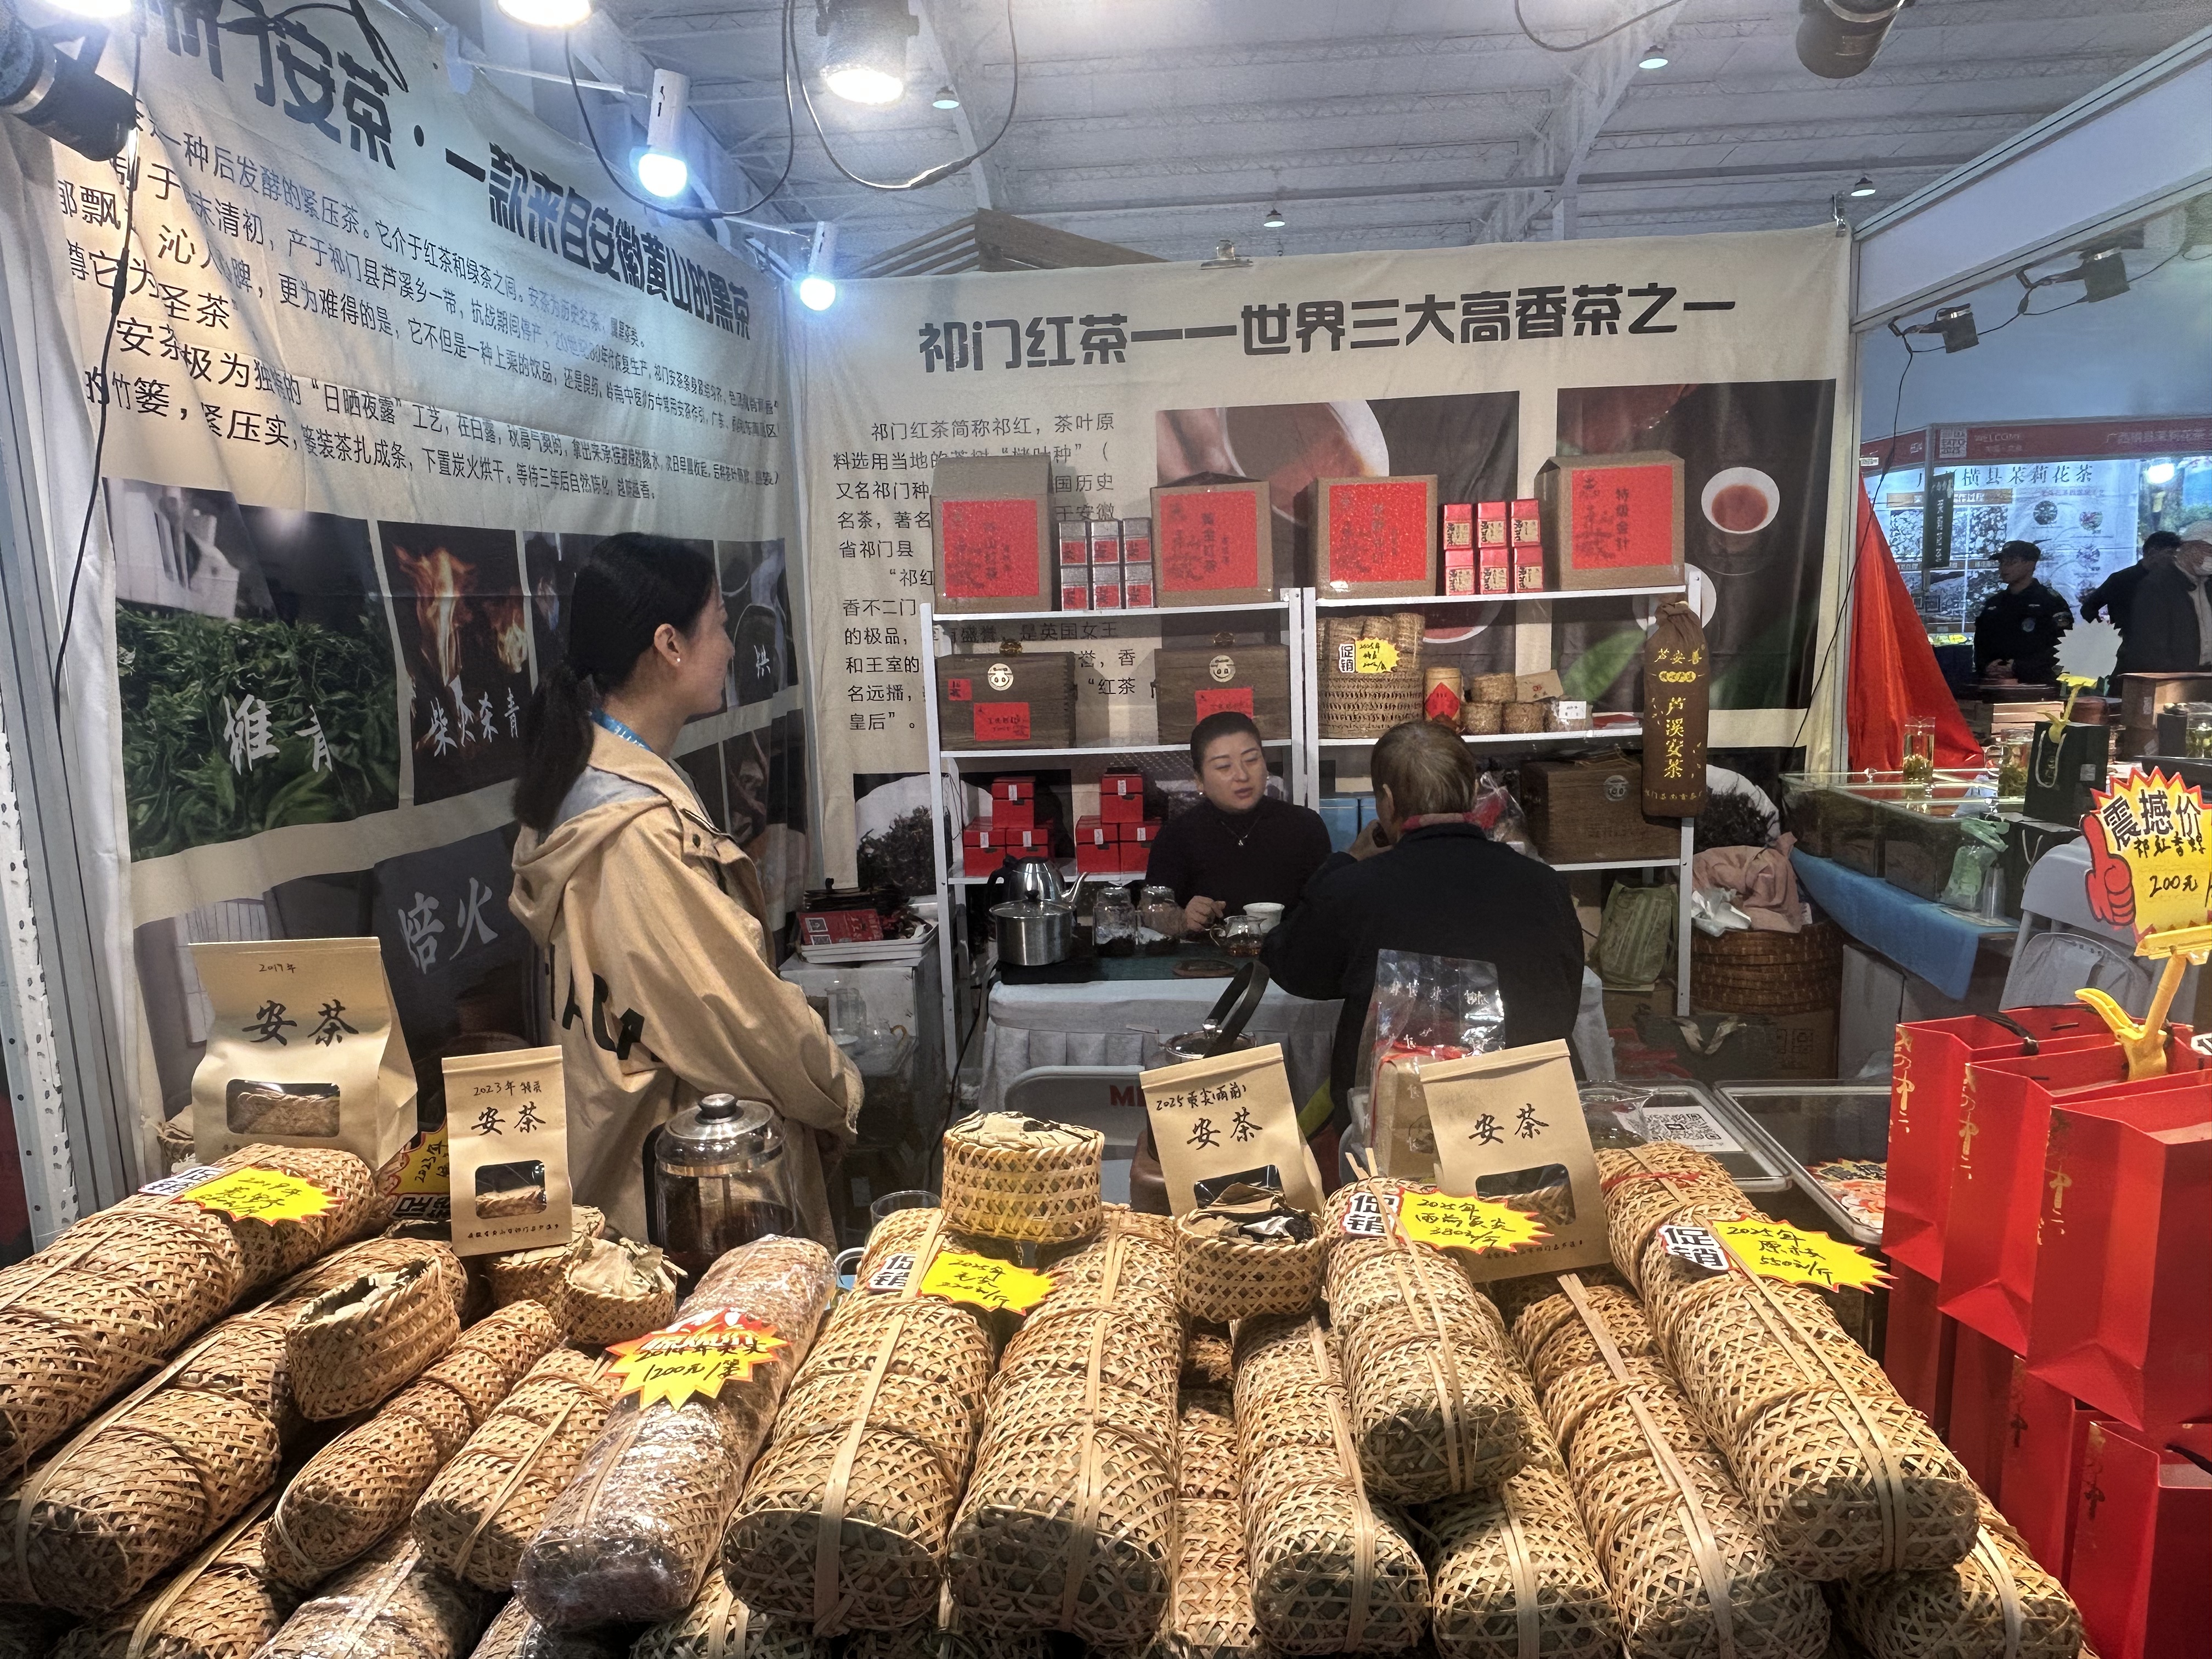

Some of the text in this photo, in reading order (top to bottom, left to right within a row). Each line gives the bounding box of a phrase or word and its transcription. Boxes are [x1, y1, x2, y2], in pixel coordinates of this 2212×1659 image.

[919, 282, 1736, 373] 祁门红茶——世界三大高香茶之一
[871, 413, 1115, 441] 祁门红茶简称祁红，茶叶原
[836, 473, 1114, 500] 又名祁门种 国历史
[837, 510, 931, 531] 名茶，著名
[839, 540, 915, 559] 省祁门县
[843, 598, 917, 618] 香不二门
[846, 656, 919, 677] 和王室的
[849, 712, 916, 731] 皇后”。
[2103, 789, 2203, 851] 震撼价
[2149, 874, 2200, 898] 200元
[242, 998, 359, 1047] 安茶
[471, 1101, 546, 1136] 安茶
[1187, 1107, 1263, 1150] 安茶
[1468, 1103, 1549, 1146] 安茶
